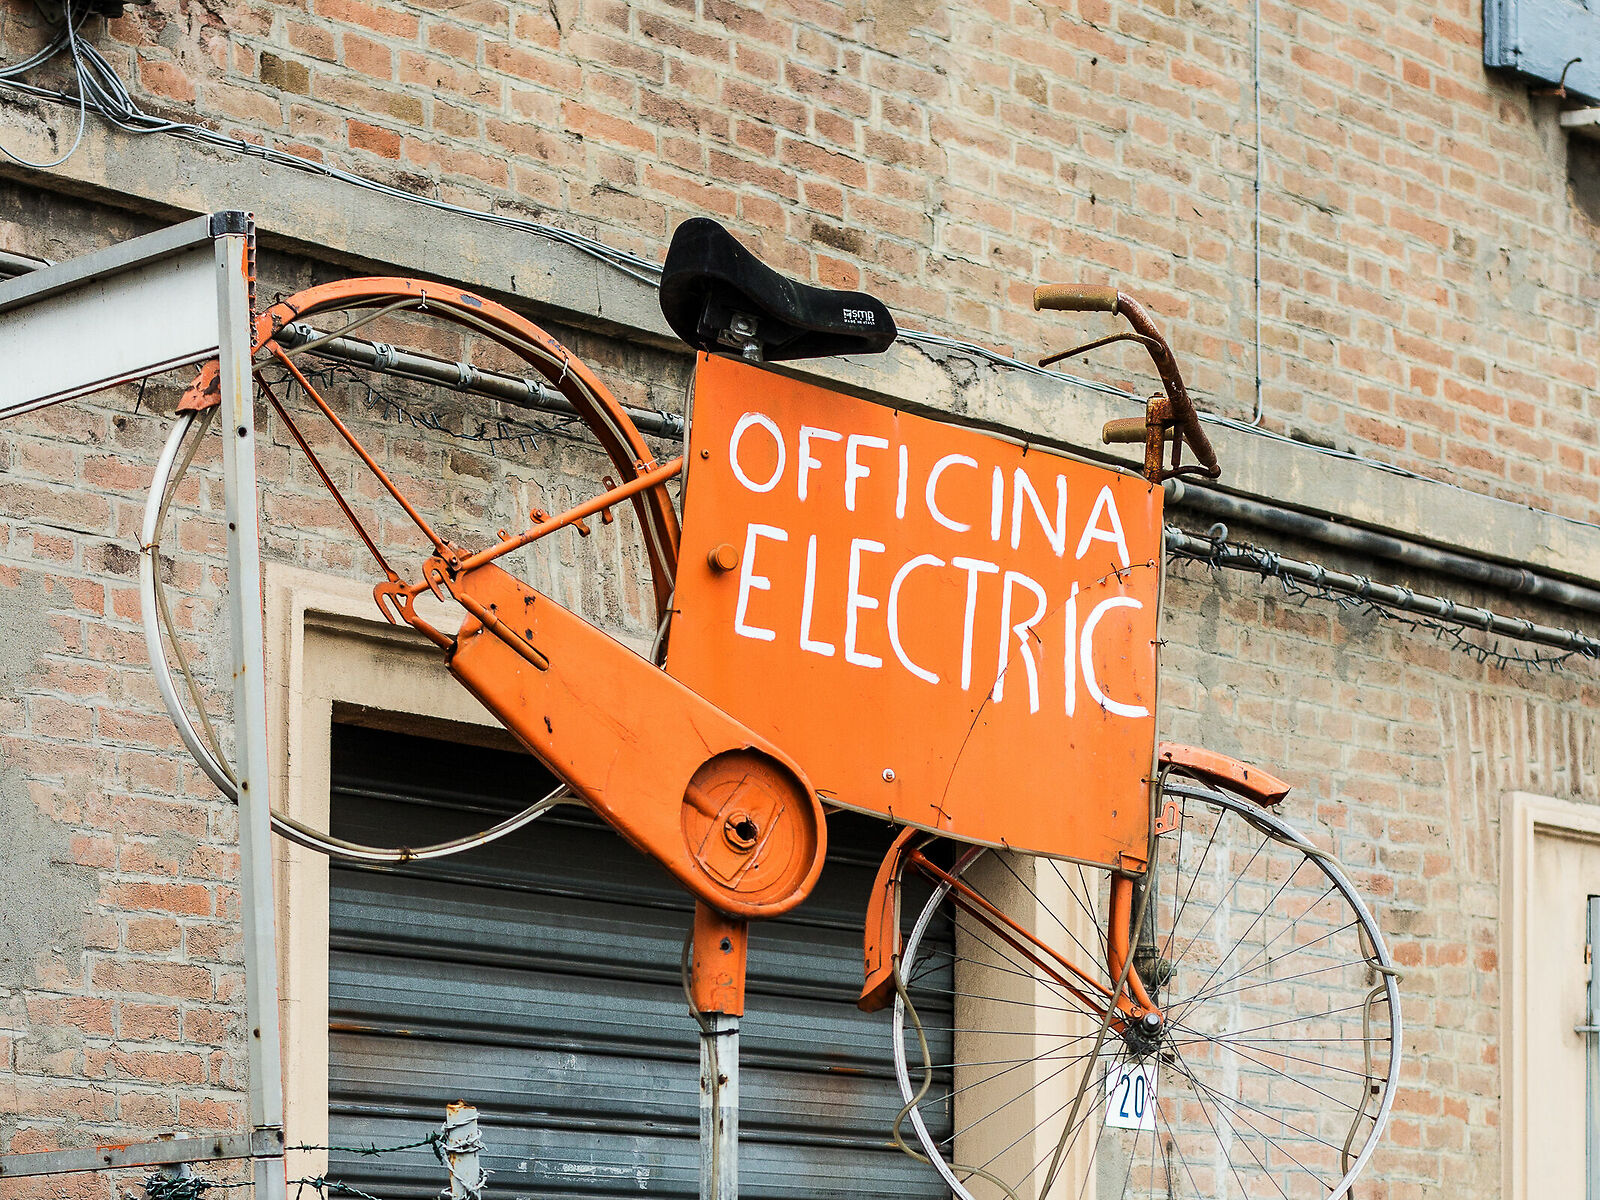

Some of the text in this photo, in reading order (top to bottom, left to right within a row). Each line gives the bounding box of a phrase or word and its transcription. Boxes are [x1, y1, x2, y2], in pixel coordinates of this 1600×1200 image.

[729, 411, 1130, 569] OFFICINA
[734, 522, 1151, 719] ELECTRIC
[1119, 1073, 1145, 1119] 20
